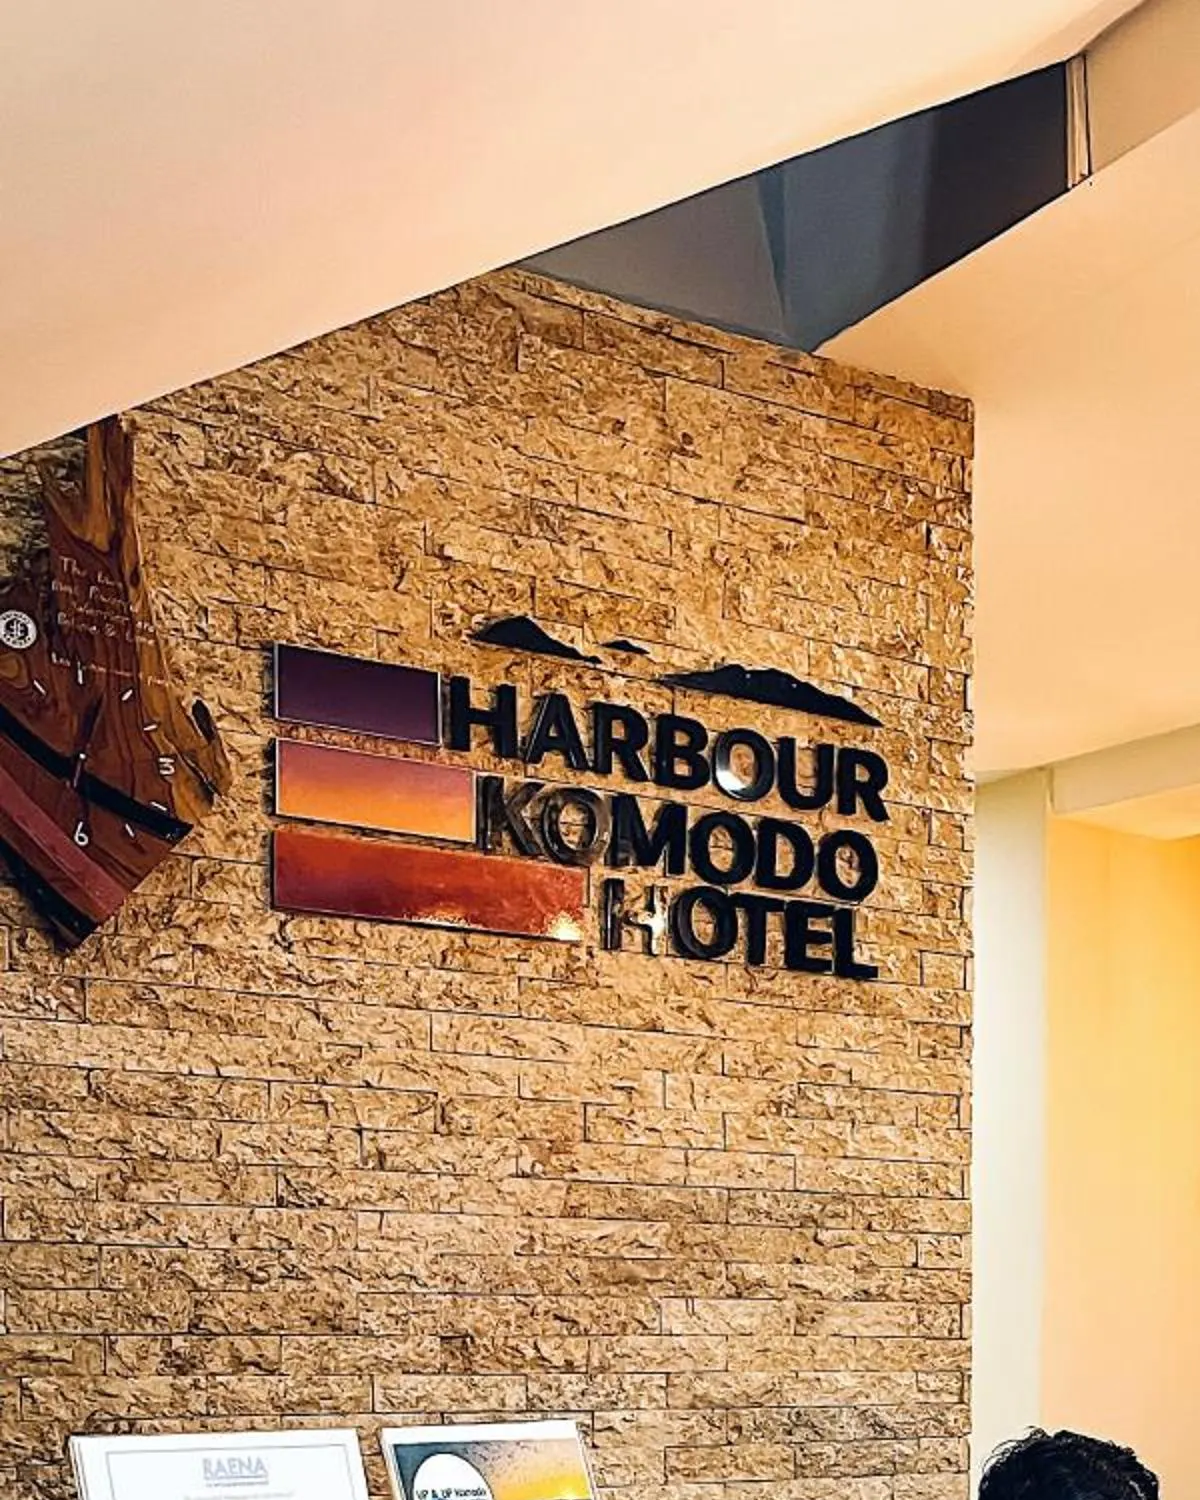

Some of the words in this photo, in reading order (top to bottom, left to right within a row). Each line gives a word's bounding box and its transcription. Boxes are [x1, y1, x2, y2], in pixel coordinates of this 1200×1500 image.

[158, 757, 175, 776] 3
[447, 676, 889, 823] HARBOUR
[73, 821, 89, 846] 6
[476, 772, 880, 902] KOMODO
[601, 878, 879, 979] HOTEL
[202, 1456, 269, 1480] RAENA
